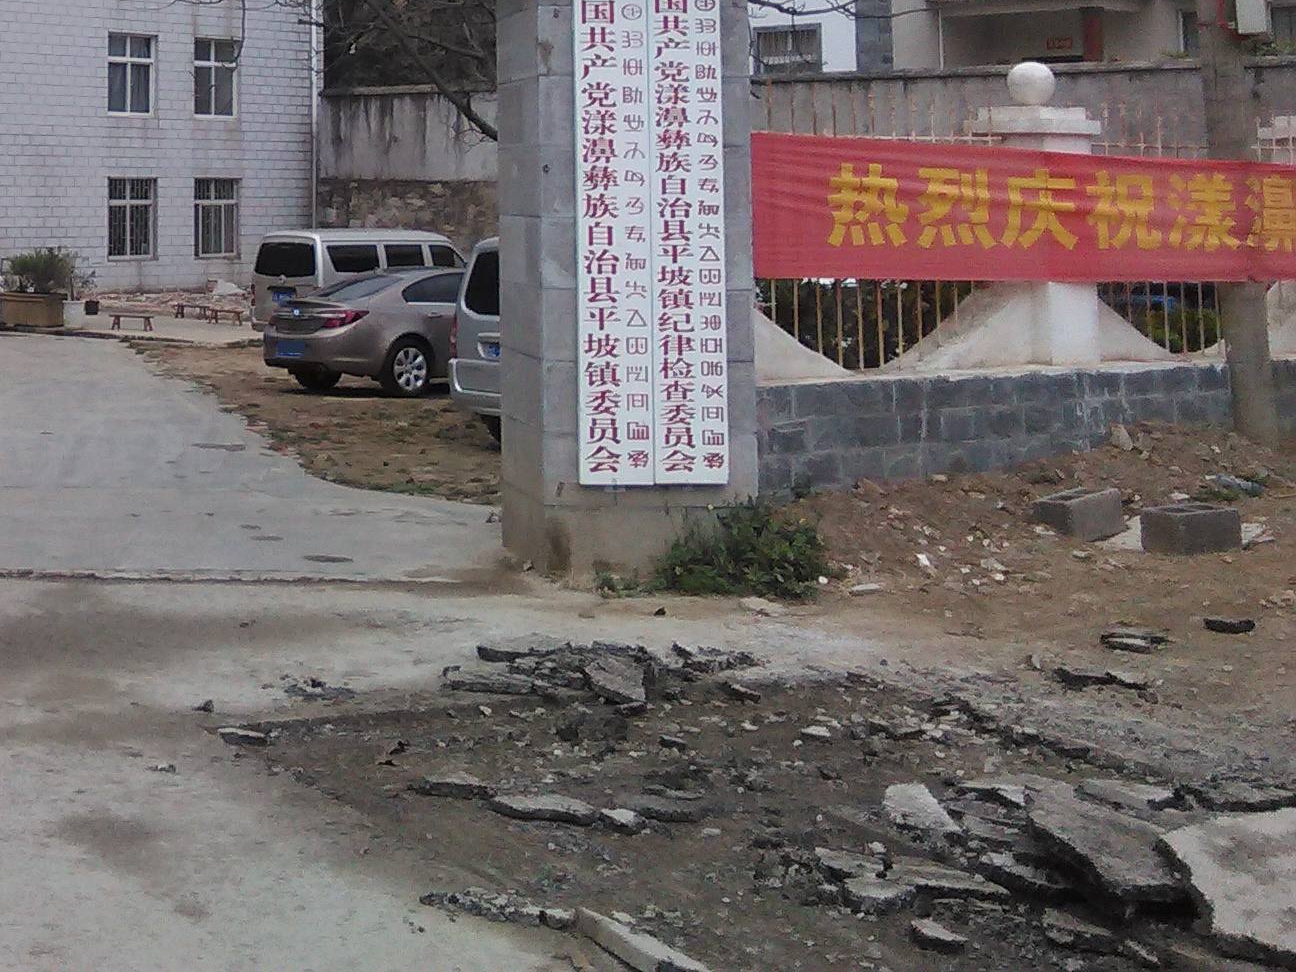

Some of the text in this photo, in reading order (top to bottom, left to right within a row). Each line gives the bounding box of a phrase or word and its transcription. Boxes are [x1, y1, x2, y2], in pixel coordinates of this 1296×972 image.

[827, 163, 1296, 253] 热烈庆祝漾濞
